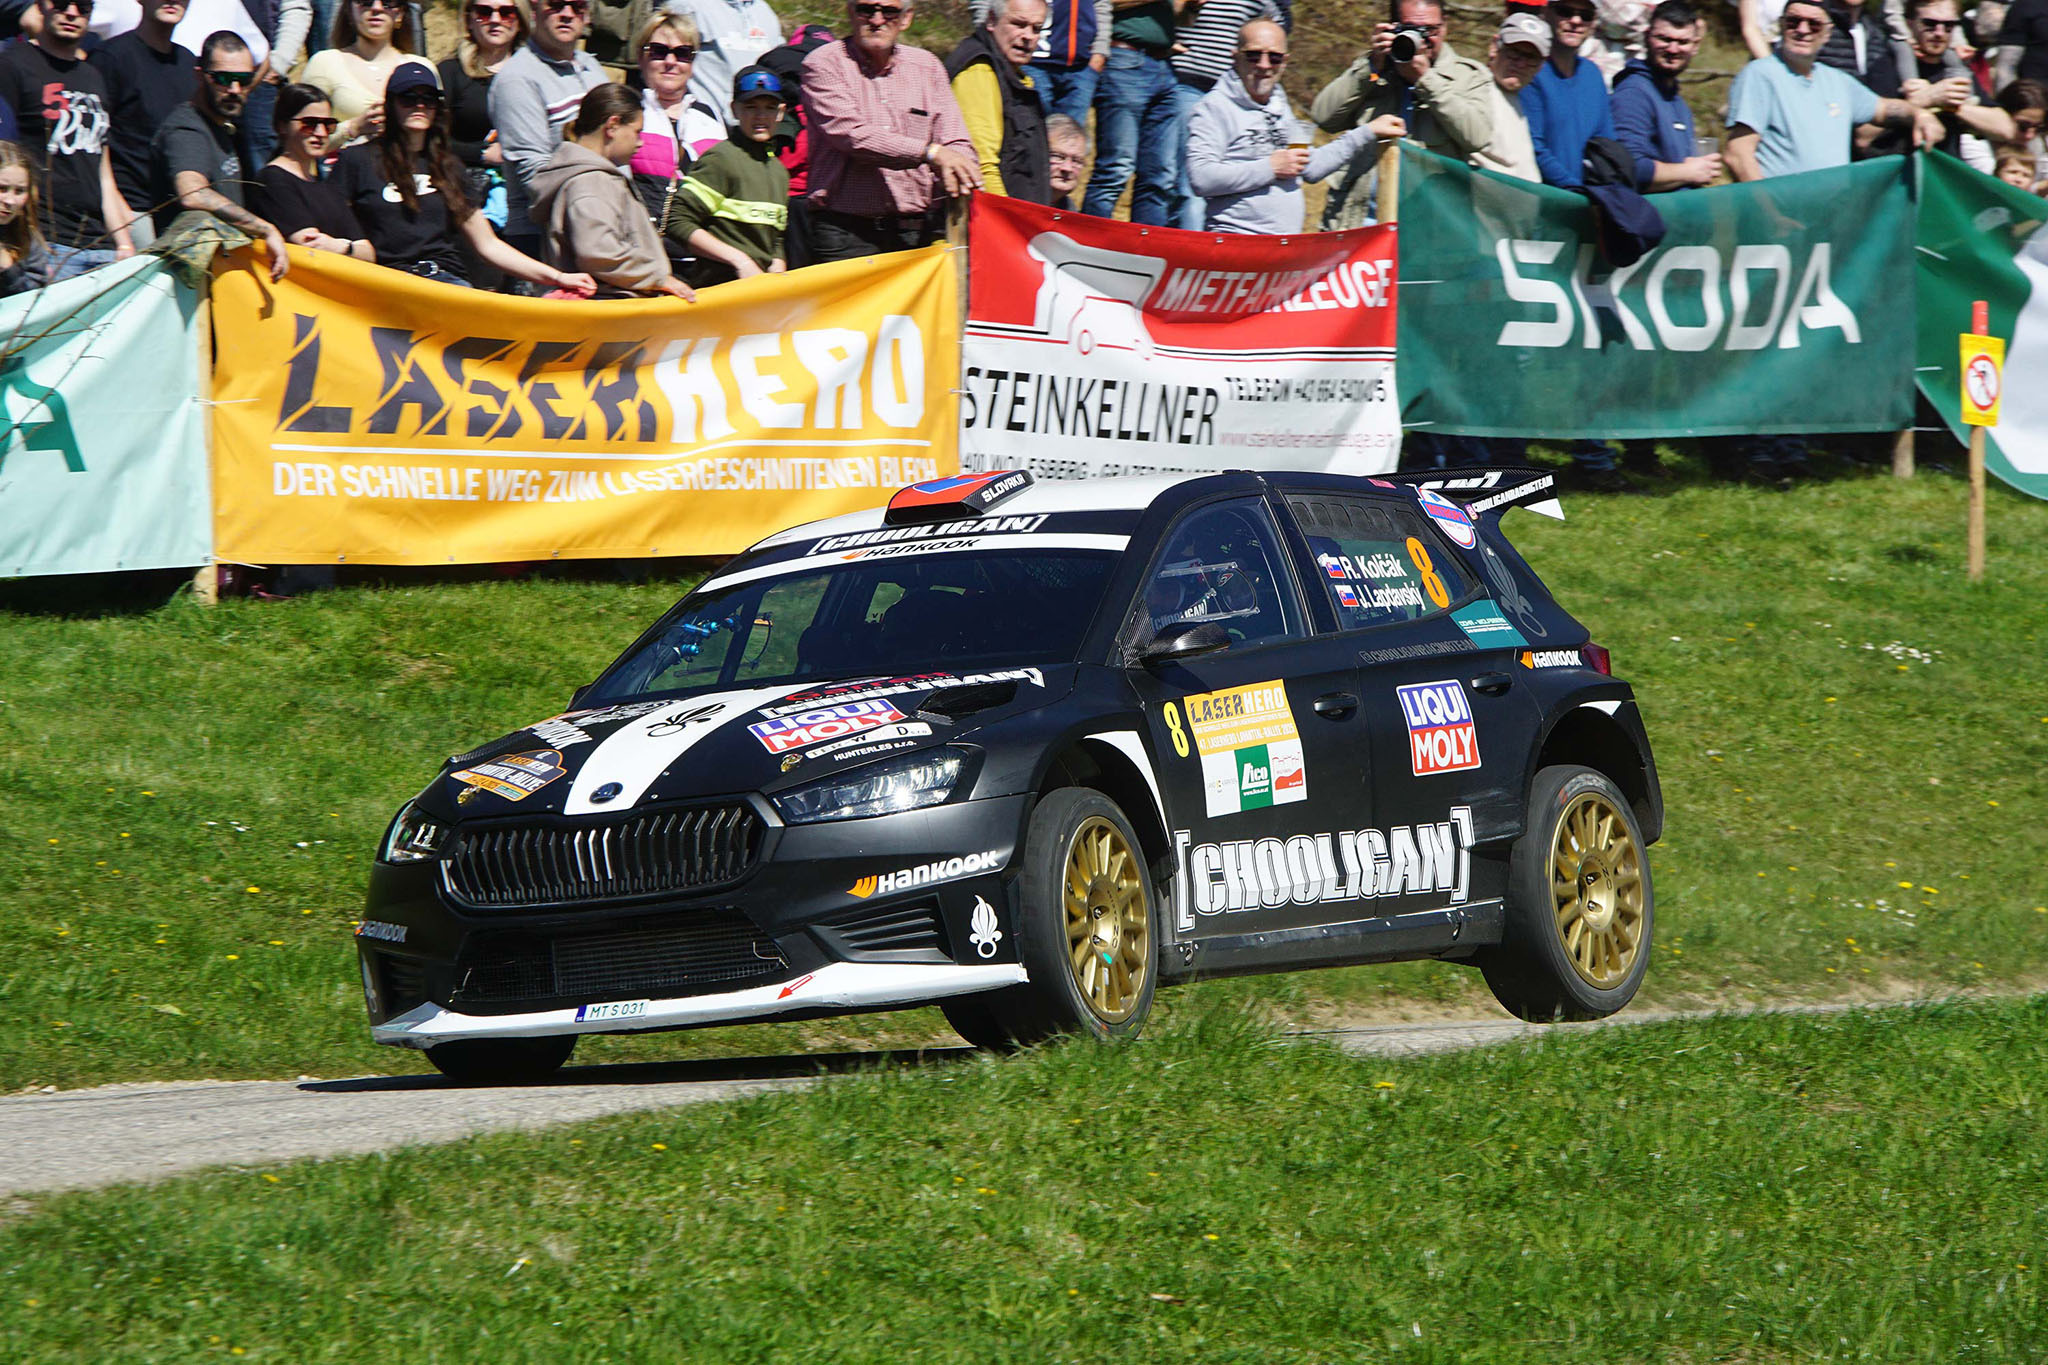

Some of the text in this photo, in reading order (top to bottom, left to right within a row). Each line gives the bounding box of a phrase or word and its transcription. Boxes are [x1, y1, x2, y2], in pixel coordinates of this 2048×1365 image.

[1153, 252, 1393, 313] MIETFAHRZEUGE
[273, 313, 925, 443] LASERHERO
[964, 366, 1219, 446] STEINKELLNER
[273, 456, 937, 503] DER SCHNELLE WEG ZUM LASERGESCHNITTENEN BLECH
[981, 473, 1025, 503] SLOVAKIA
[1339, 556, 1360, 579] R.
[1406, 536, 1449, 608] 8
[1356, 585, 1372, 608] J.
[761, 699, 890, 736] LIQUI
[1190, 687, 1285, 723] LASERHERO
[1401, 685, 1468, 726] LIQUI
[773, 711, 904, 751] MOLY
[1163, 702, 1190, 758] 8
[1414, 726, 1473, 769] MOLY
[833, 743, 893, 761] HUNTERLES
